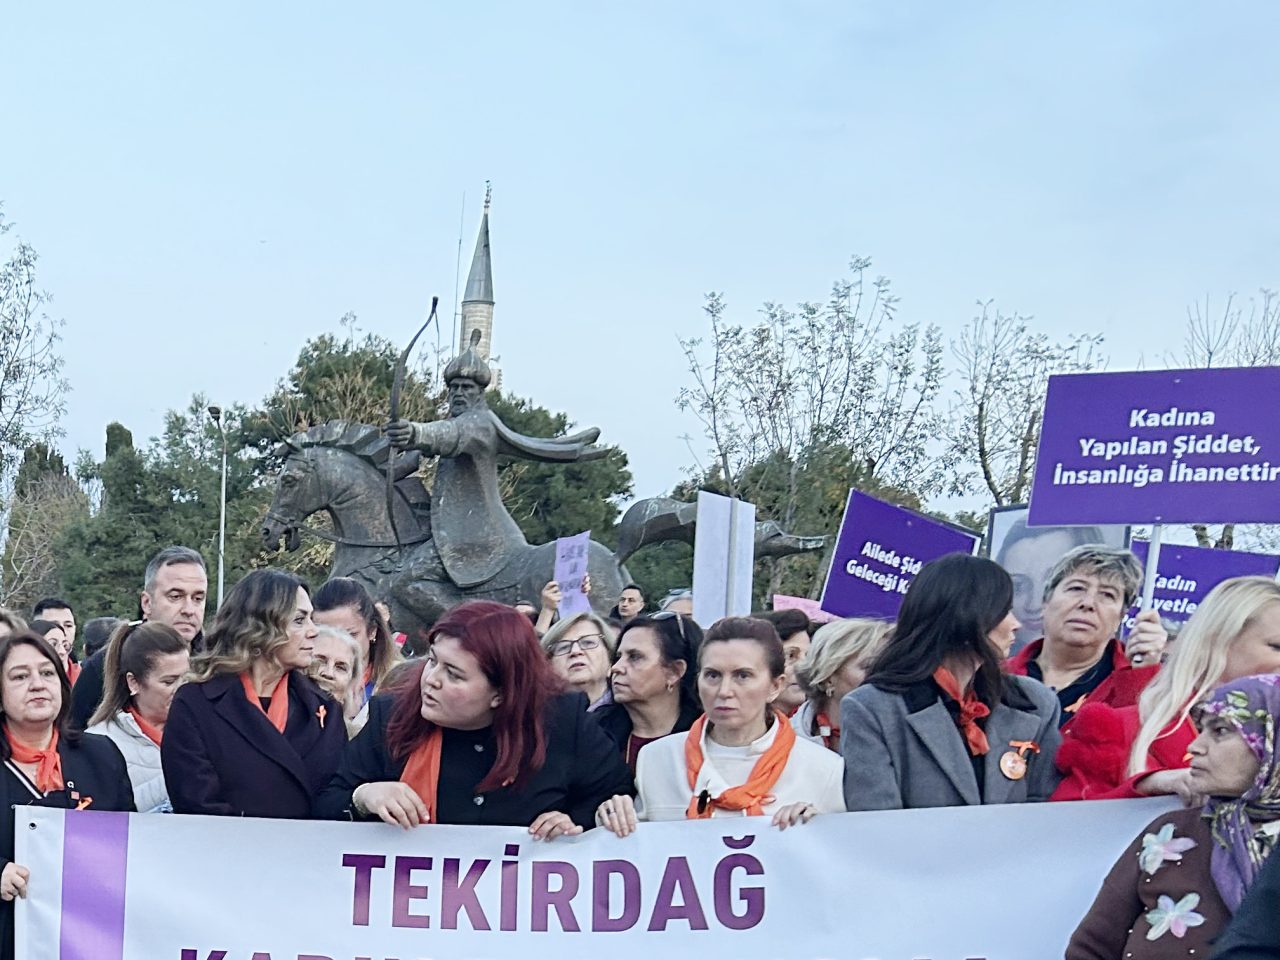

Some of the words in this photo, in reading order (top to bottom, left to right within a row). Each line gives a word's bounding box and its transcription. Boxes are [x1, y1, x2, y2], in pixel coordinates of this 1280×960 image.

[1129, 407, 1216, 428] Kadına
[1078, 436, 1168, 461] Yapılan
[1173, 434, 1262, 459] Şiddet,
[1052, 462, 1164, 488] İnsanlığa
[1168, 459, 1280, 483] İhanettir
[861, 541, 900, 568] Ailede
[900, 556, 923, 575] Şid
[846, 559, 899, 592] Geleceği
[342, 835, 766, 932] TEKİRDAĞ
